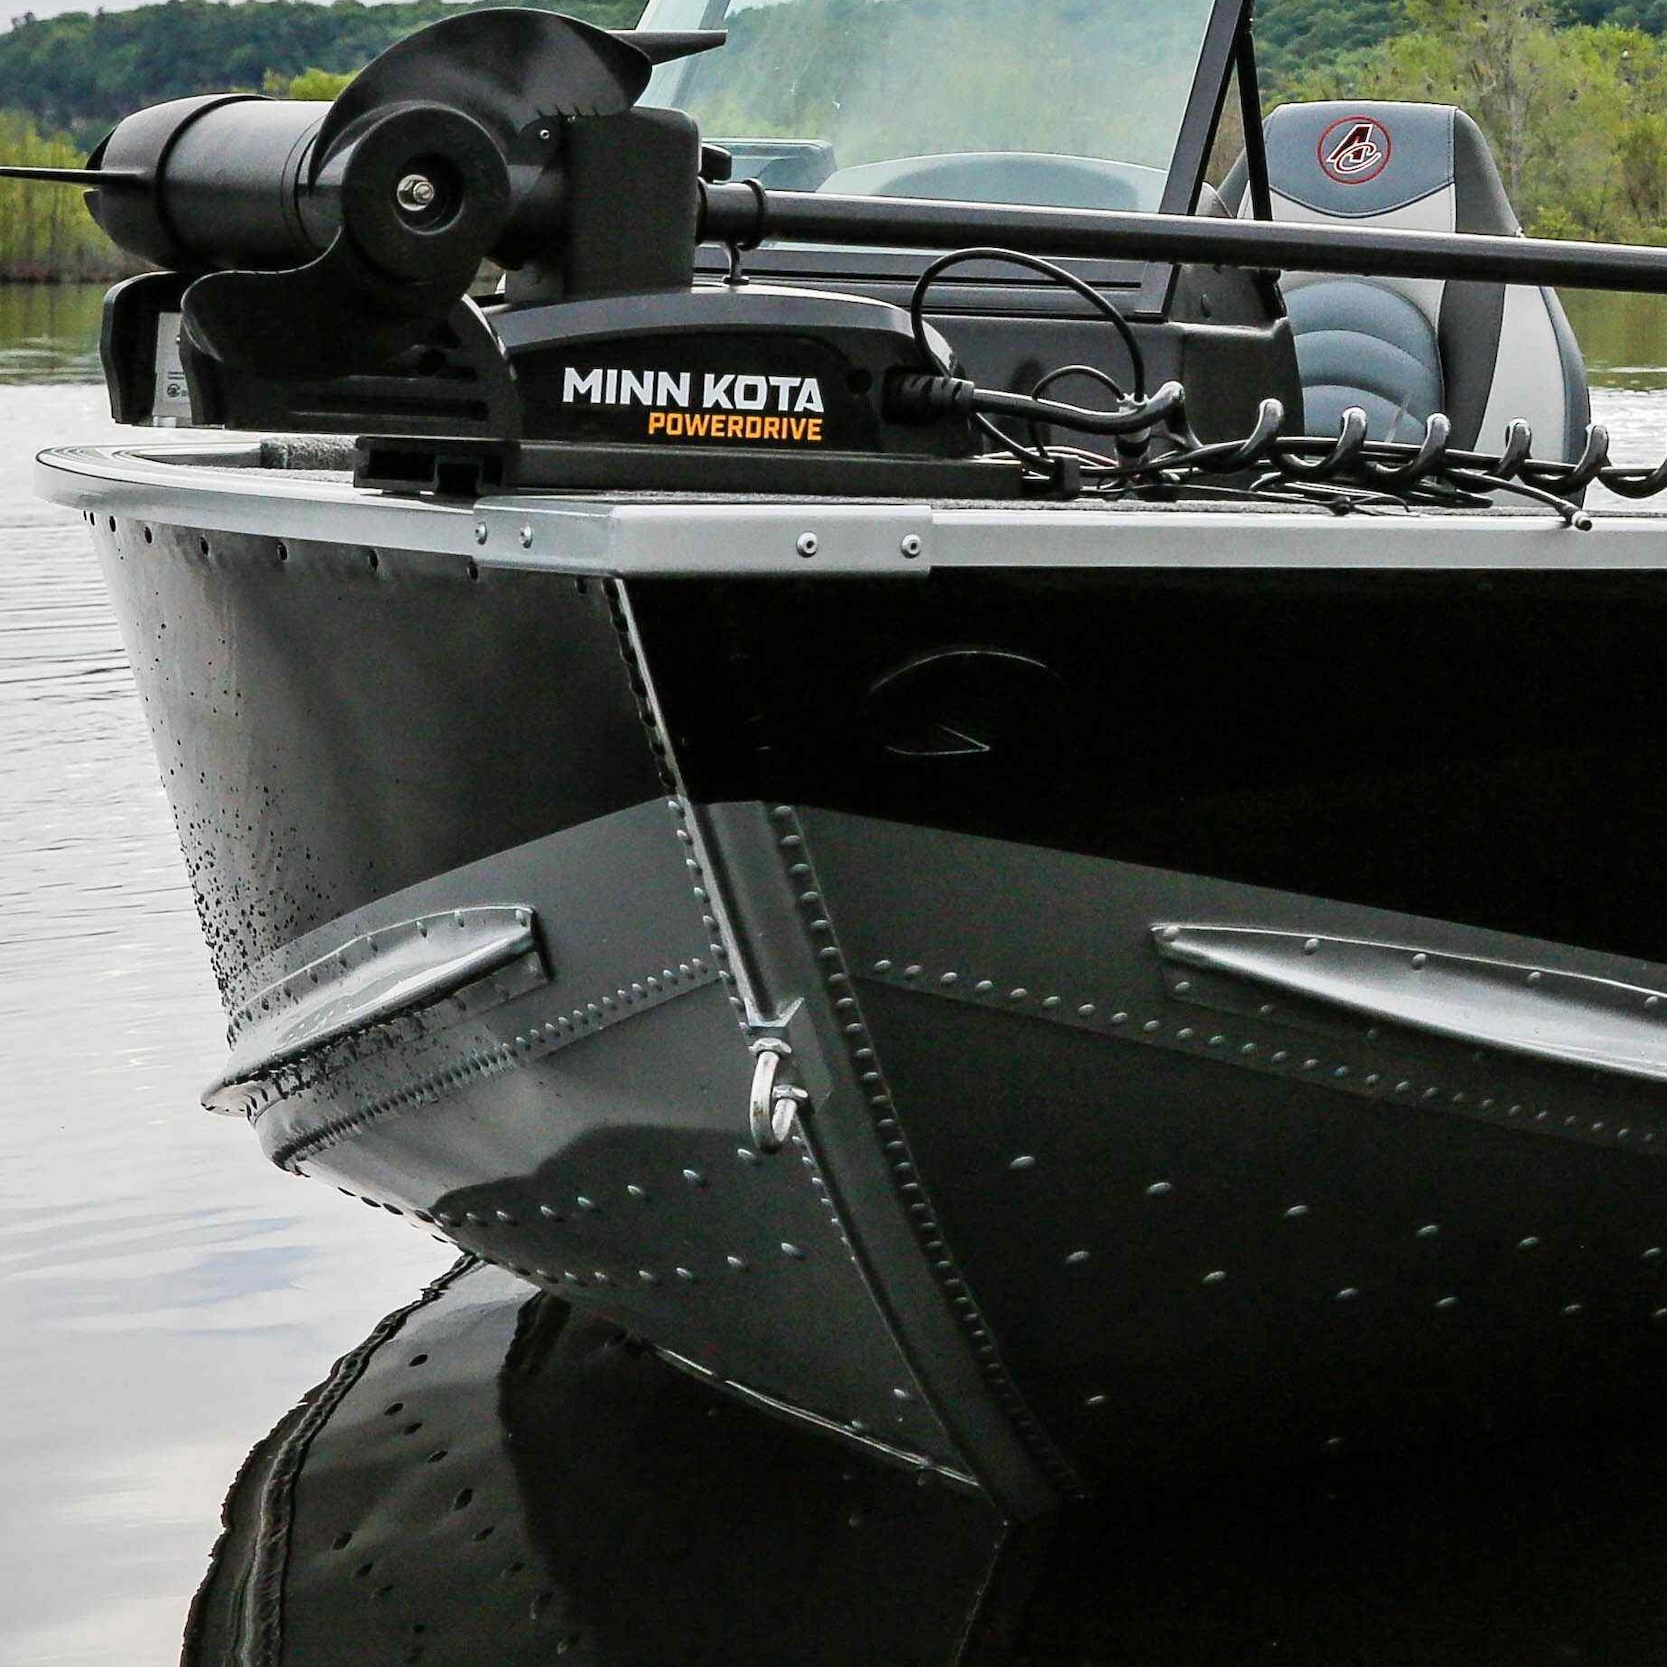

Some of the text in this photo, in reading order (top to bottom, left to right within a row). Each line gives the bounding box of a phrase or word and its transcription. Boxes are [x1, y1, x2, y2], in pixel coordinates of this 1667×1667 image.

[562, 367, 825, 413] MINN KOTA
[648, 411, 823, 441] POWERDRIVE
